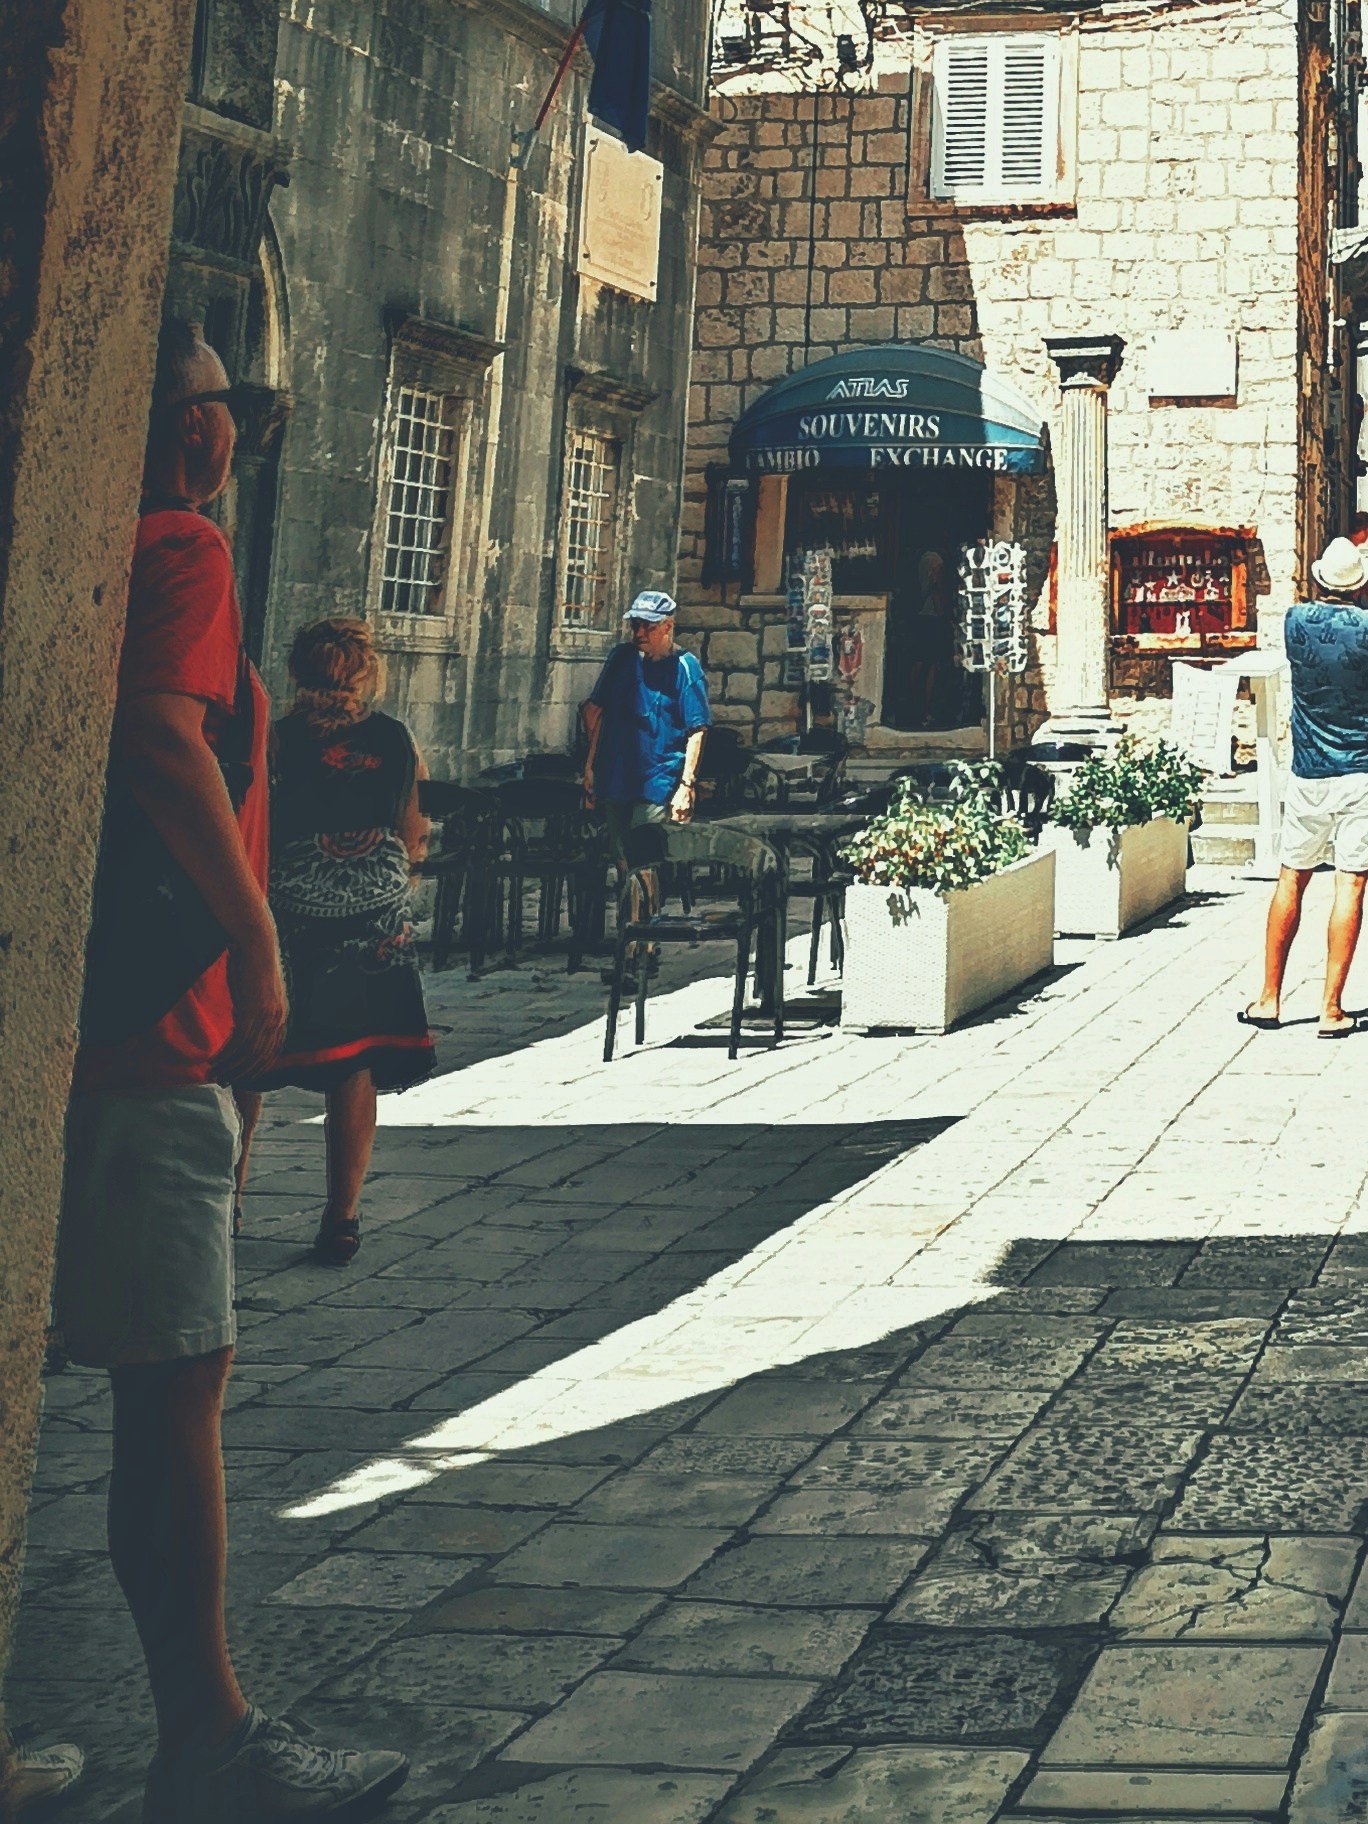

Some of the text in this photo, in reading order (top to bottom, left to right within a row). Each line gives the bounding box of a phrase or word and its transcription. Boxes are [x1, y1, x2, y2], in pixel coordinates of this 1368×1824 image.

[825, 377, 910, 400] ATLAS
[798, 413, 941, 440] SOUVENIRS
[745, 447, 1008, 471] CAMBIO EXCHANGE
